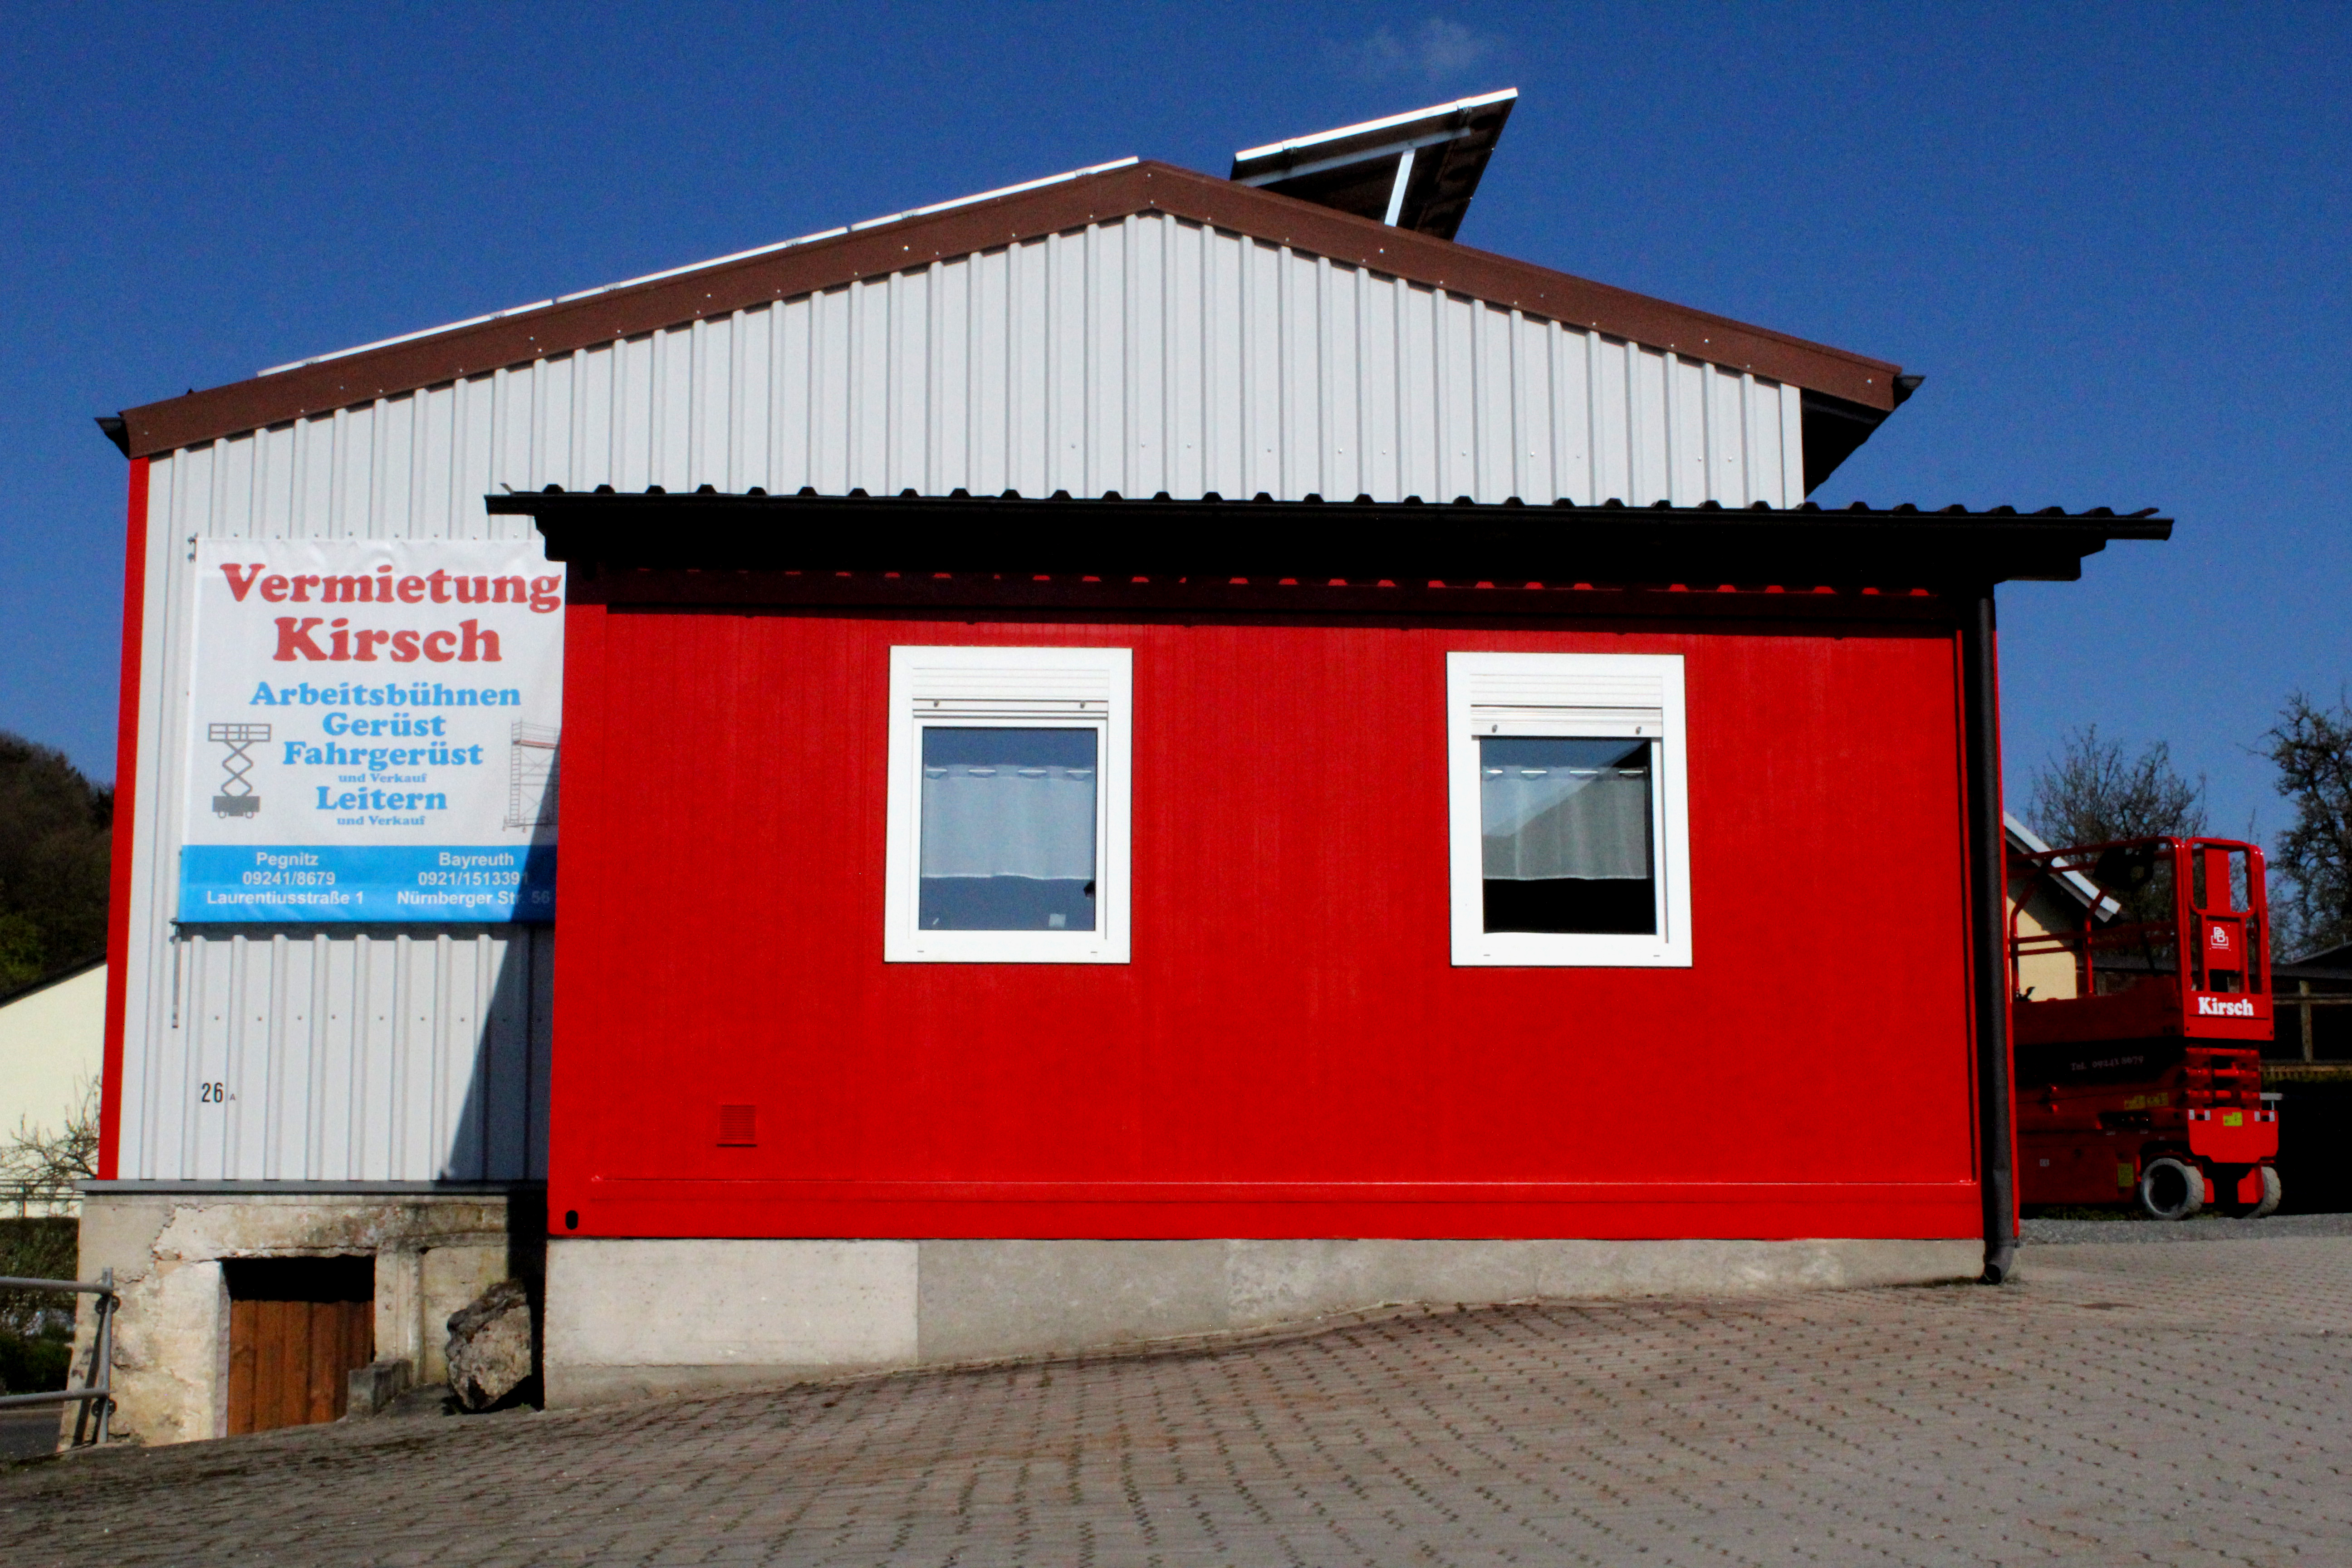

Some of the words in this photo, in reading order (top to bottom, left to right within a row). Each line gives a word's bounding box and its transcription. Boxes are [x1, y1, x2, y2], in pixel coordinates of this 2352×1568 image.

[220, 563, 562, 613] Vermietung
[273, 617, 502, 663] Kirsch
[249, 681, 521, 706] Arbeitsbühnen
[322, 712, 446, 737] Gerüst
[282, 741, 484, 771] Fahrgerüst
[338, 773, 366, 783] und
[369, 772, 427, 784] Verkauf
[315, 786, 447, 811] Leitern
[337, 815, 364, 826] und
[368, 815, 426, 826] Verkauf
[256, 852, 318, 868] Pegnitz
[438, 852, 514, 869] Bayreuth
[242, 871, 335, 886] 09241/8679
[418, 871, 528, 886] 0921/1513391
[207, 890, 350, 905] Laurentiusstraße
[355, 891, 363, 904] 1
[397, 890, 493, 908] Nürnberger
[2198, 997, 2254, 1016] Kirsch
[202, 1083, 224, 1102] 26
